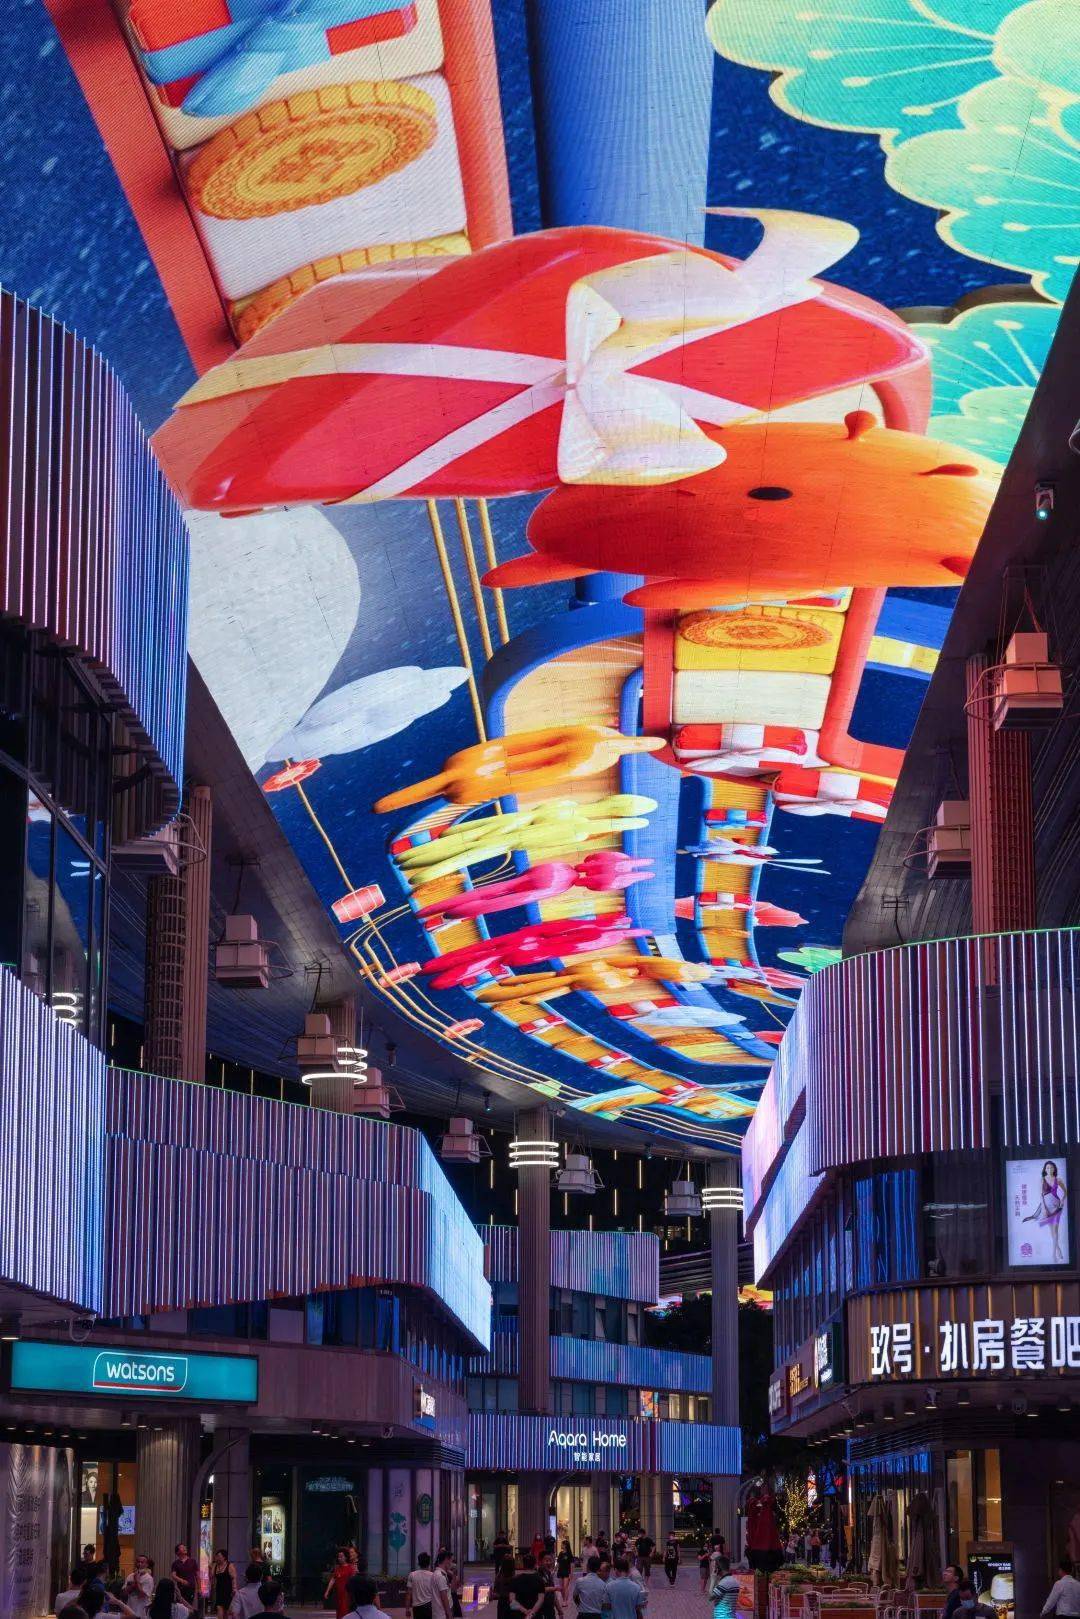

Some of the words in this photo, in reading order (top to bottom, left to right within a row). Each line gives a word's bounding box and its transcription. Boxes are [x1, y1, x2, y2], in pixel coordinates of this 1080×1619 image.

[106, 1361, 175, 1382] watsons
[548, 1430, 587, 1449] Aqara
[592, 1431, 627, 1447] Home
